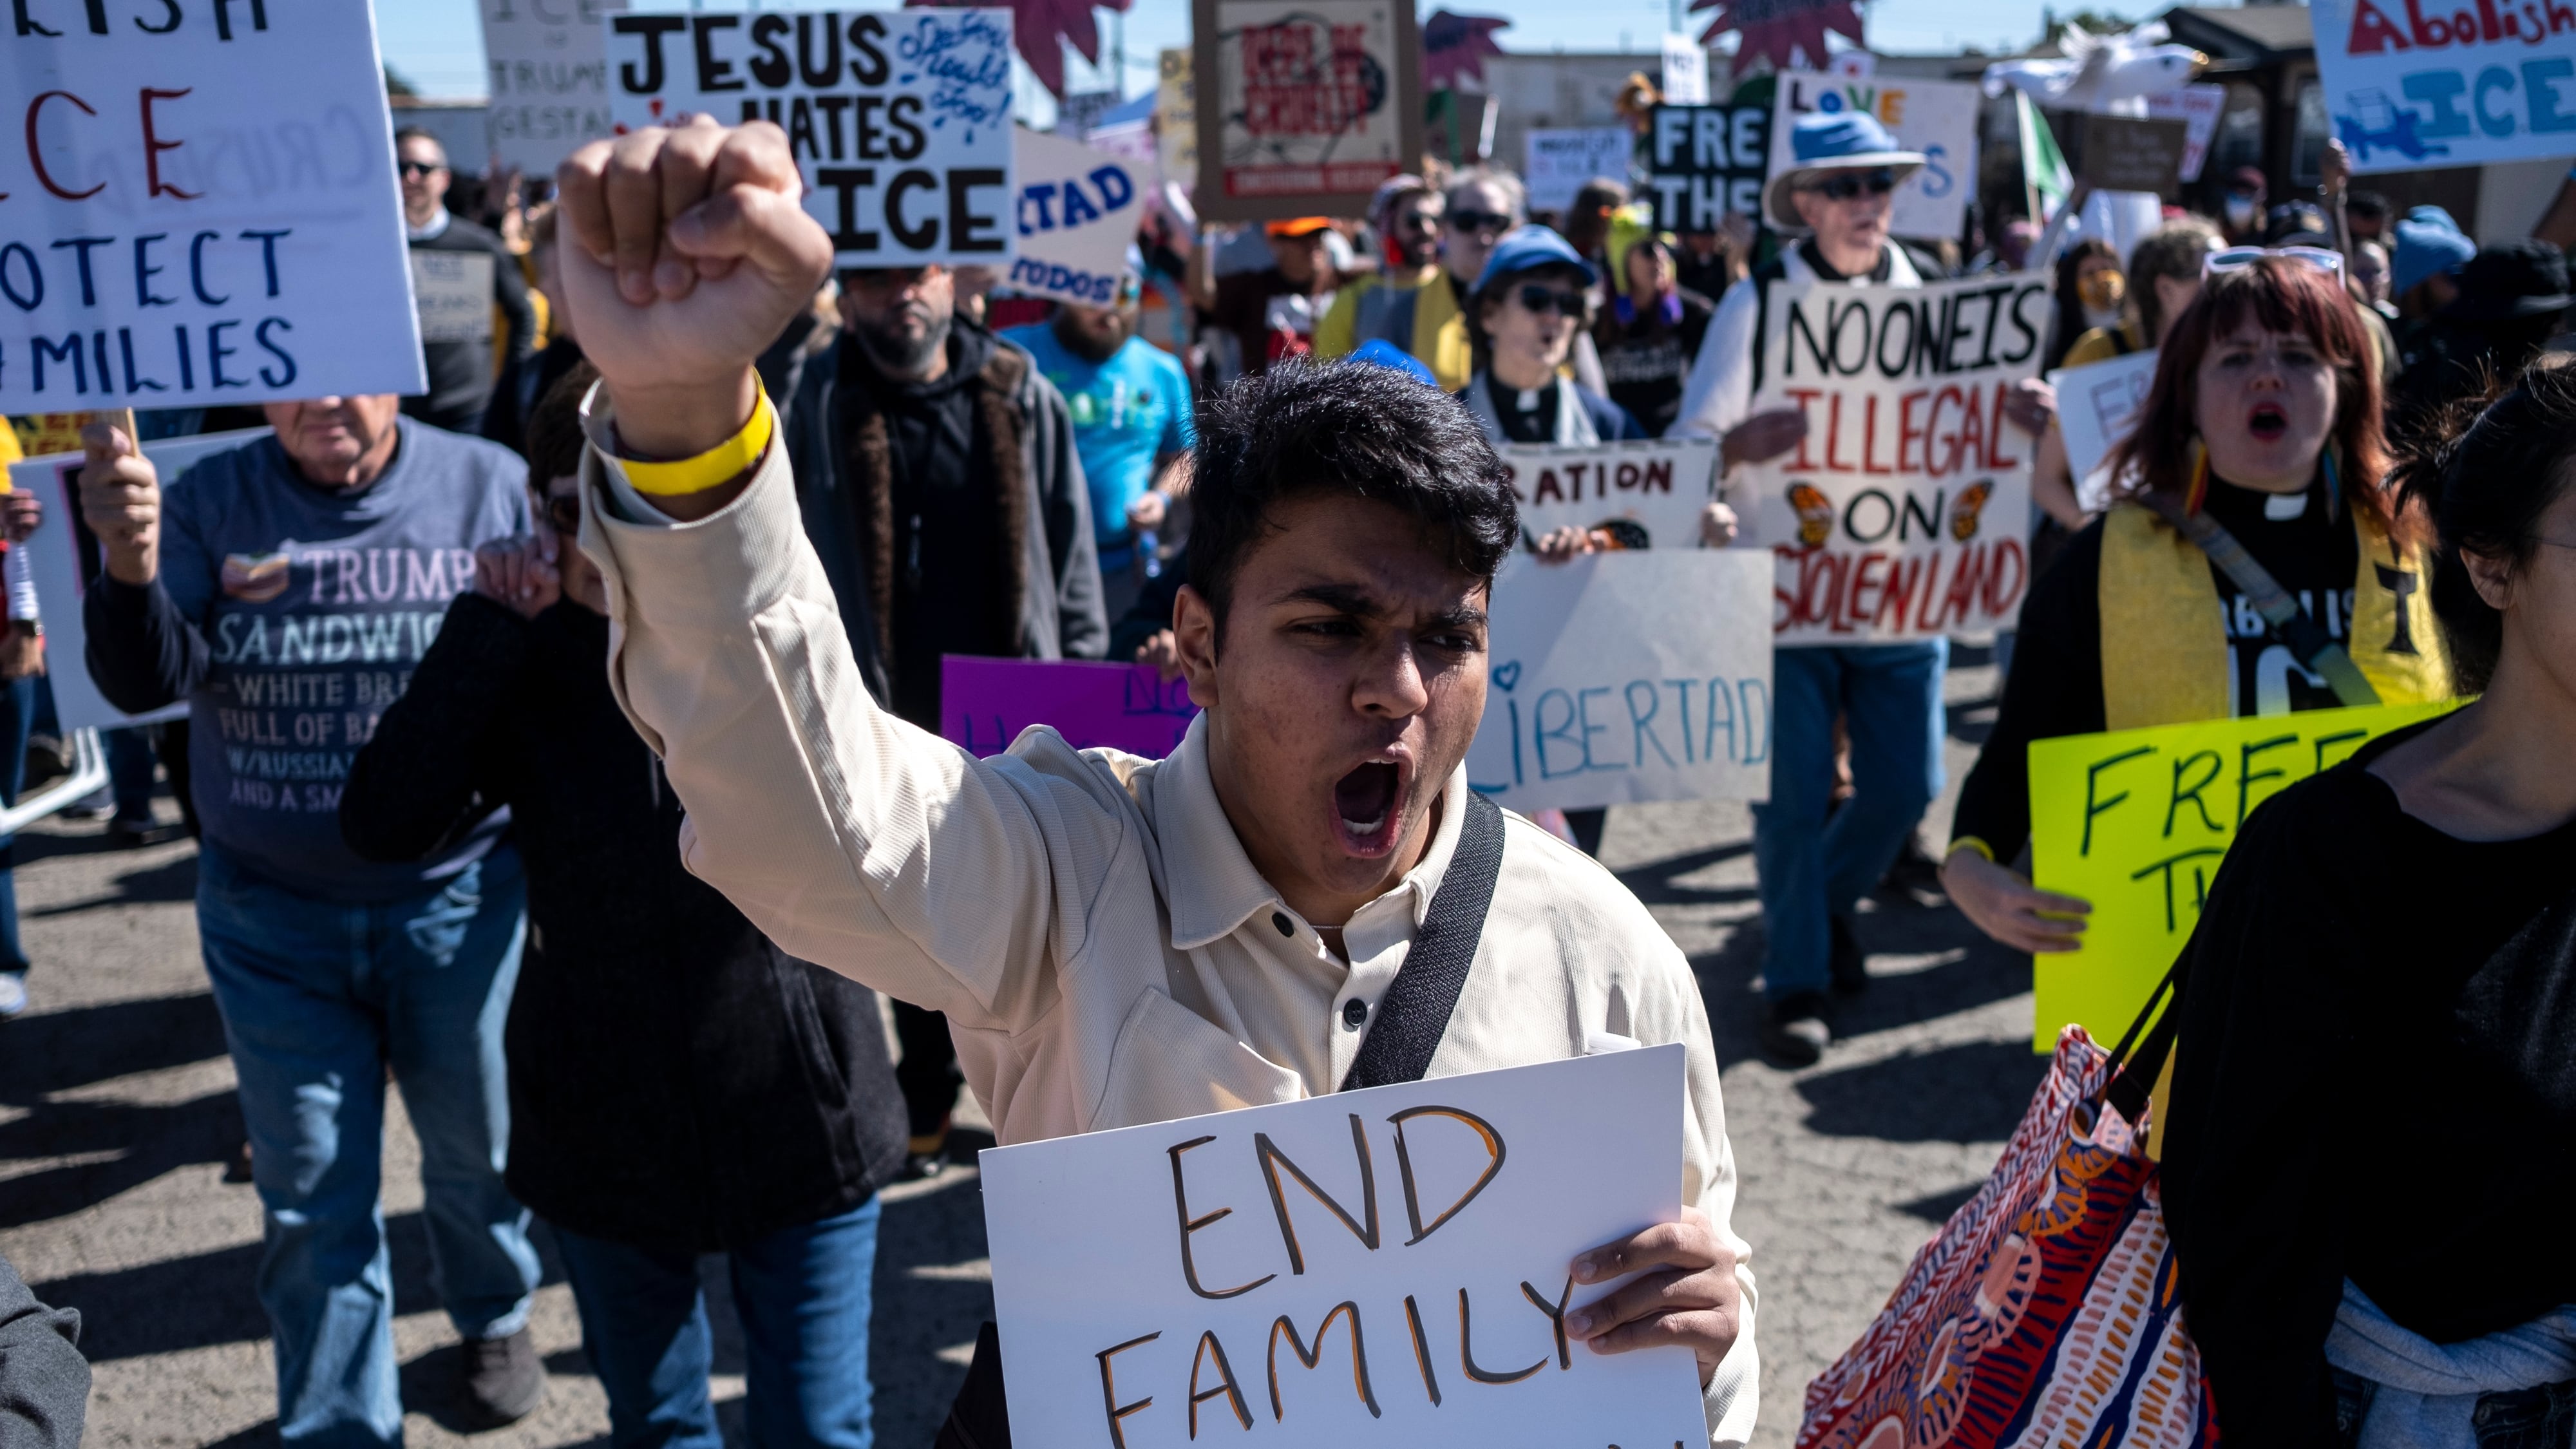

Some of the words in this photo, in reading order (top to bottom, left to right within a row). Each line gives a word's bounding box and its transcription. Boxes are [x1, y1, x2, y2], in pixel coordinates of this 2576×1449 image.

[613, 13, 890, 93] JESUS
[2347, 0, 2576, 55] Abolish
[1790, 81, 1908, 126] LOVE
[2401, 57, 2576, 139] ICE
[0, 86, 204, 201] CE
[1654, 107, 1765, 169] FRE
[815, 169, 1006, 253] ICE
[1018, 164, 1135, 236] TAD
[1653, 174, 1765, 231] THE
[1, 229, 292, 312] OTECT
[0, 317, 298, 394] MILIES
[1781, 383, 2018, 477] ILLEGAL
[1844, 488, 1944, 544] ON
[303, 547, 477, 604] TRUMP
[234, 672, 345, 707] WHITE
[218, 707, 287, 746] FULL
[294, 712, 335, 747] OF
[229, 778, 274, 811] AND
[279, 784, 299, 813] A
[1166, 1104, 1506, 1300] END
[1095, 1273, 1577, 1449] FAMILY
